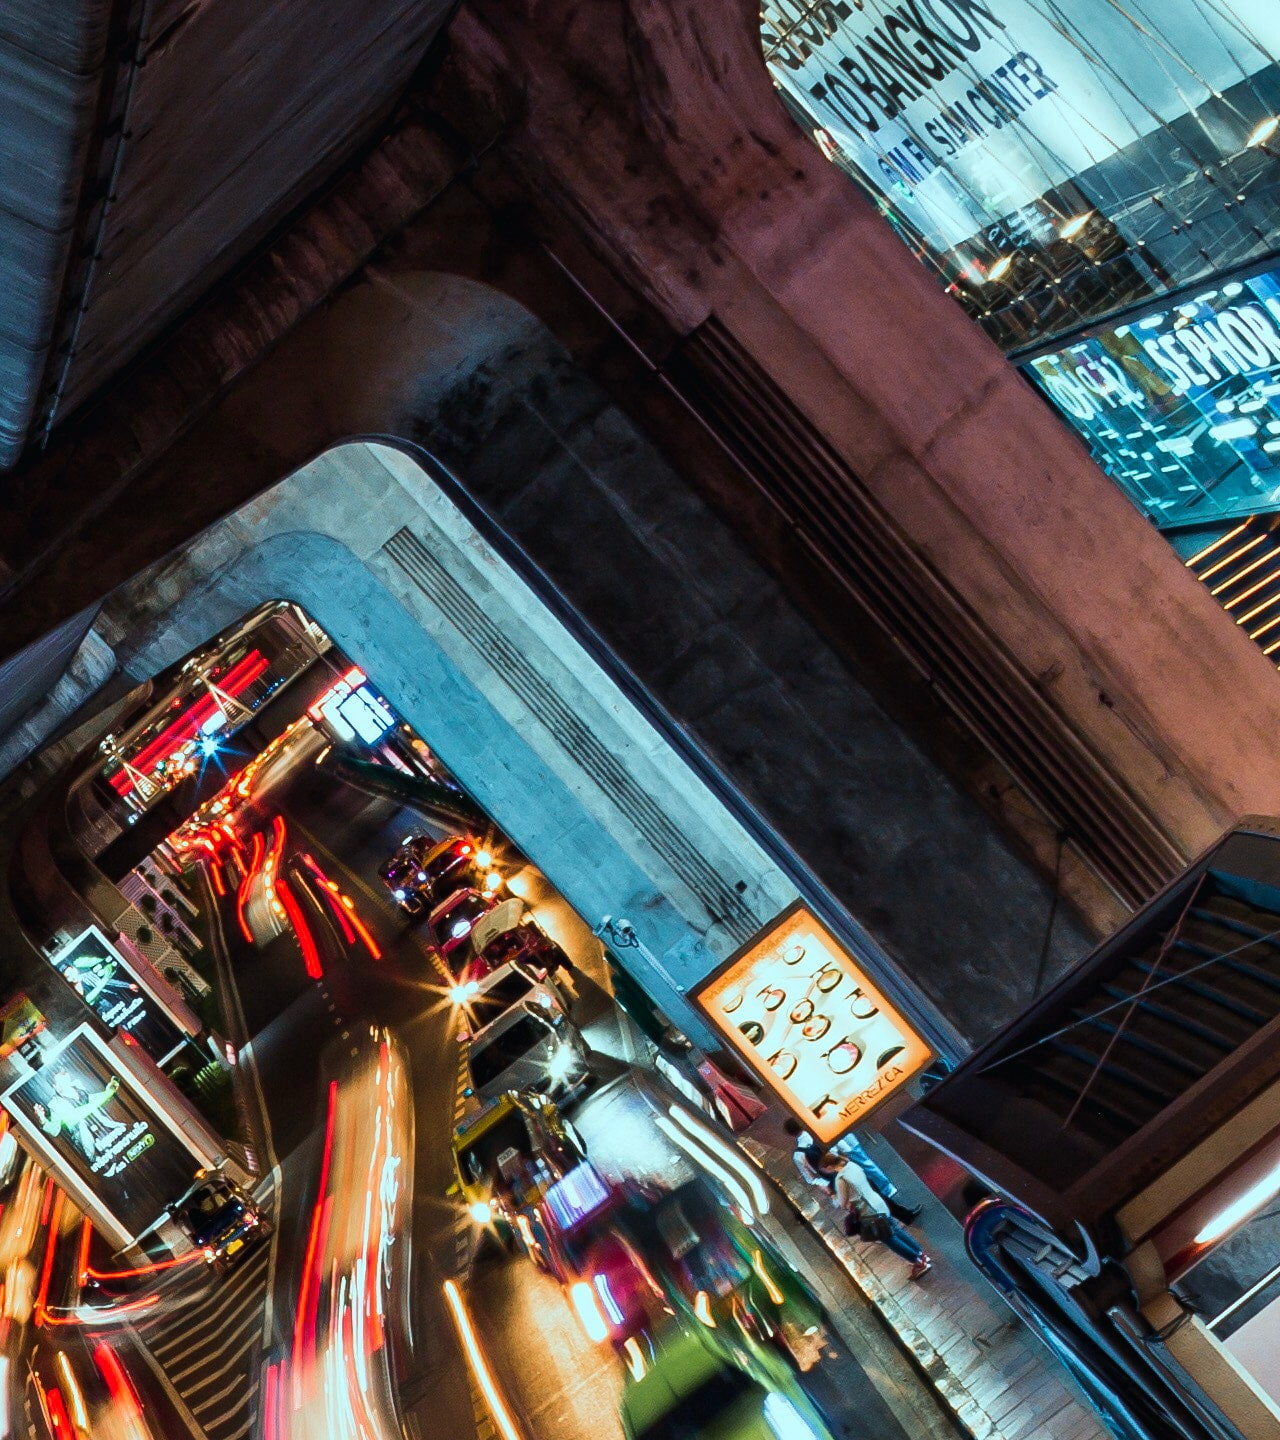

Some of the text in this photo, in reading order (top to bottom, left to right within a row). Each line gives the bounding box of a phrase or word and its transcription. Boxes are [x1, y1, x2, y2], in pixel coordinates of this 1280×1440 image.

[809, 72, 881, 142] TO
[924, 100, 989, 157] SIAM
[965, 50, 1059, 130] CENTER
[1143, 298, 1280, 392] SEPHOR
